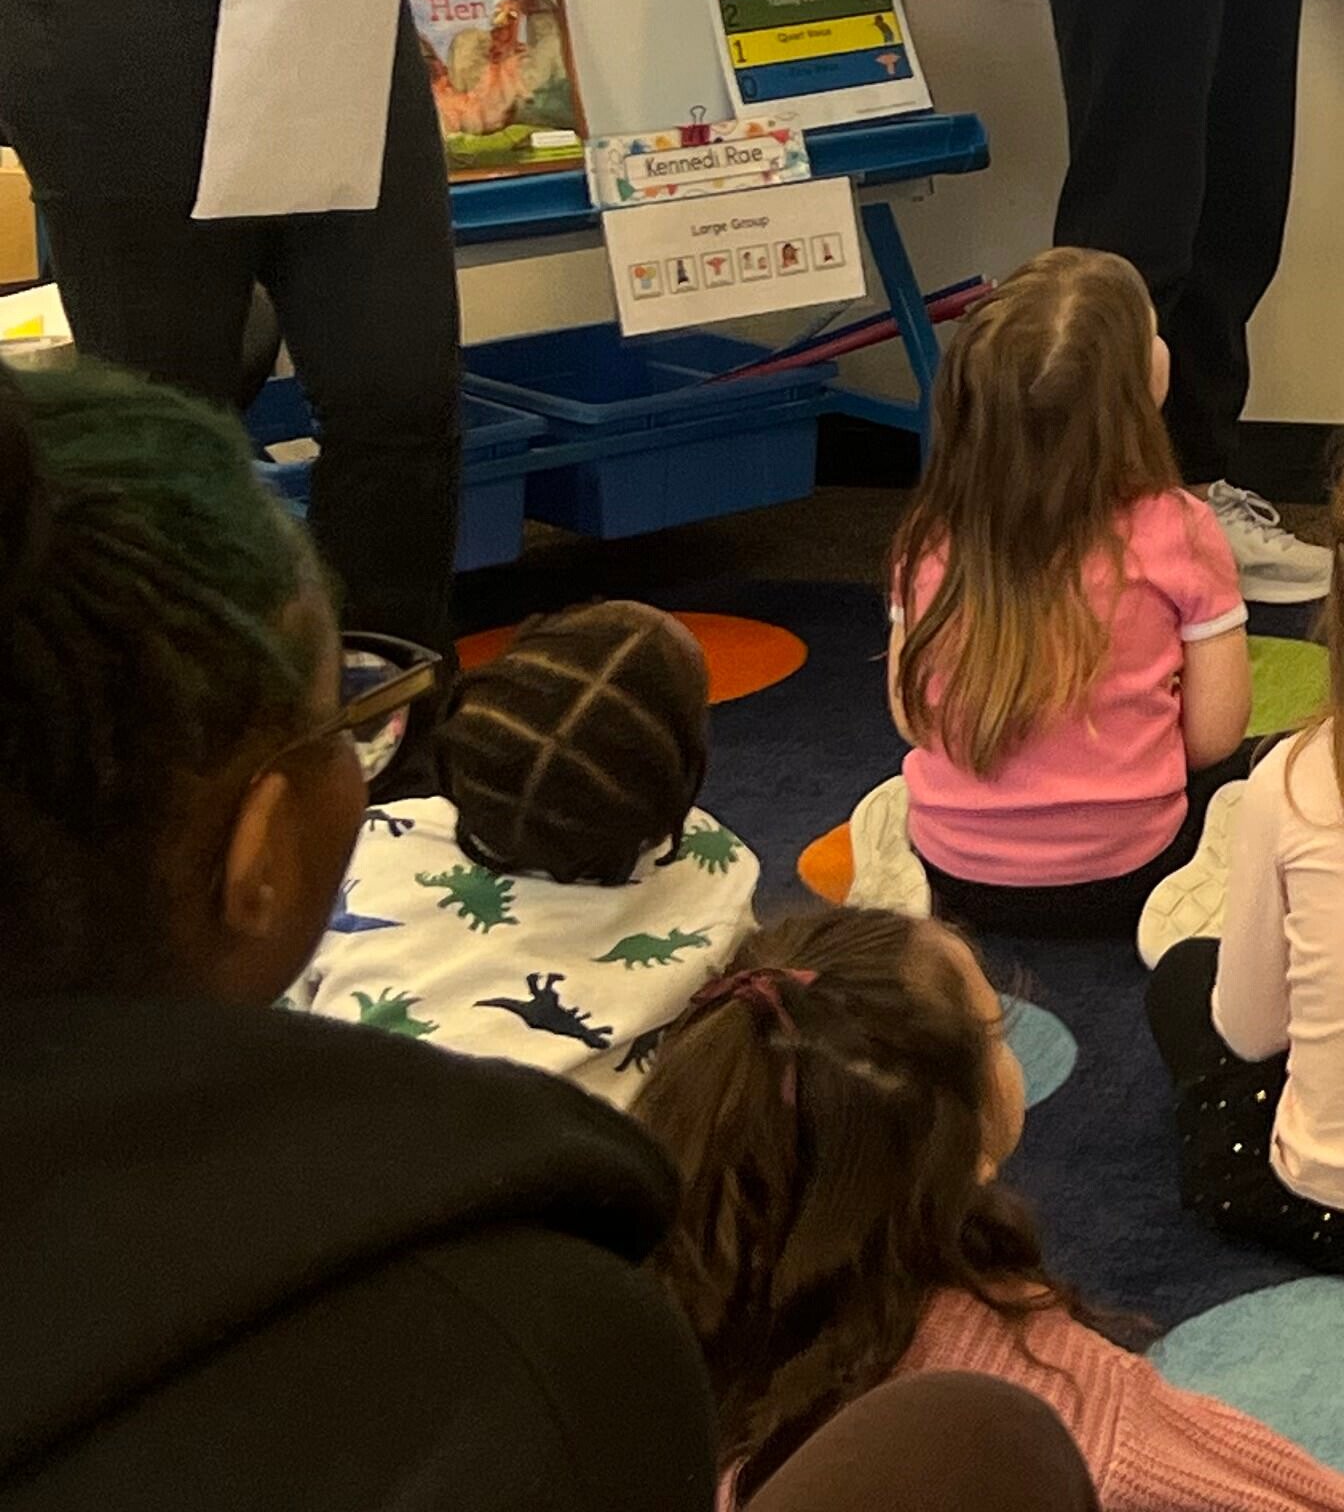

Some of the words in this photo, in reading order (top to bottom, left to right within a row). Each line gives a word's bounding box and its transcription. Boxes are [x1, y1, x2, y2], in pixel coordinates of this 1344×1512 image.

[723, 4, 738, 27] 2
[733, 40, 747, 63] 1
[742, 75, 758, 98] 0
[645, 149, 721, 177] Kennedi
[725, 145, 764, 166] Rae
[690, 224, 727, 238] Large
[730, 216, 770, 230] Group
